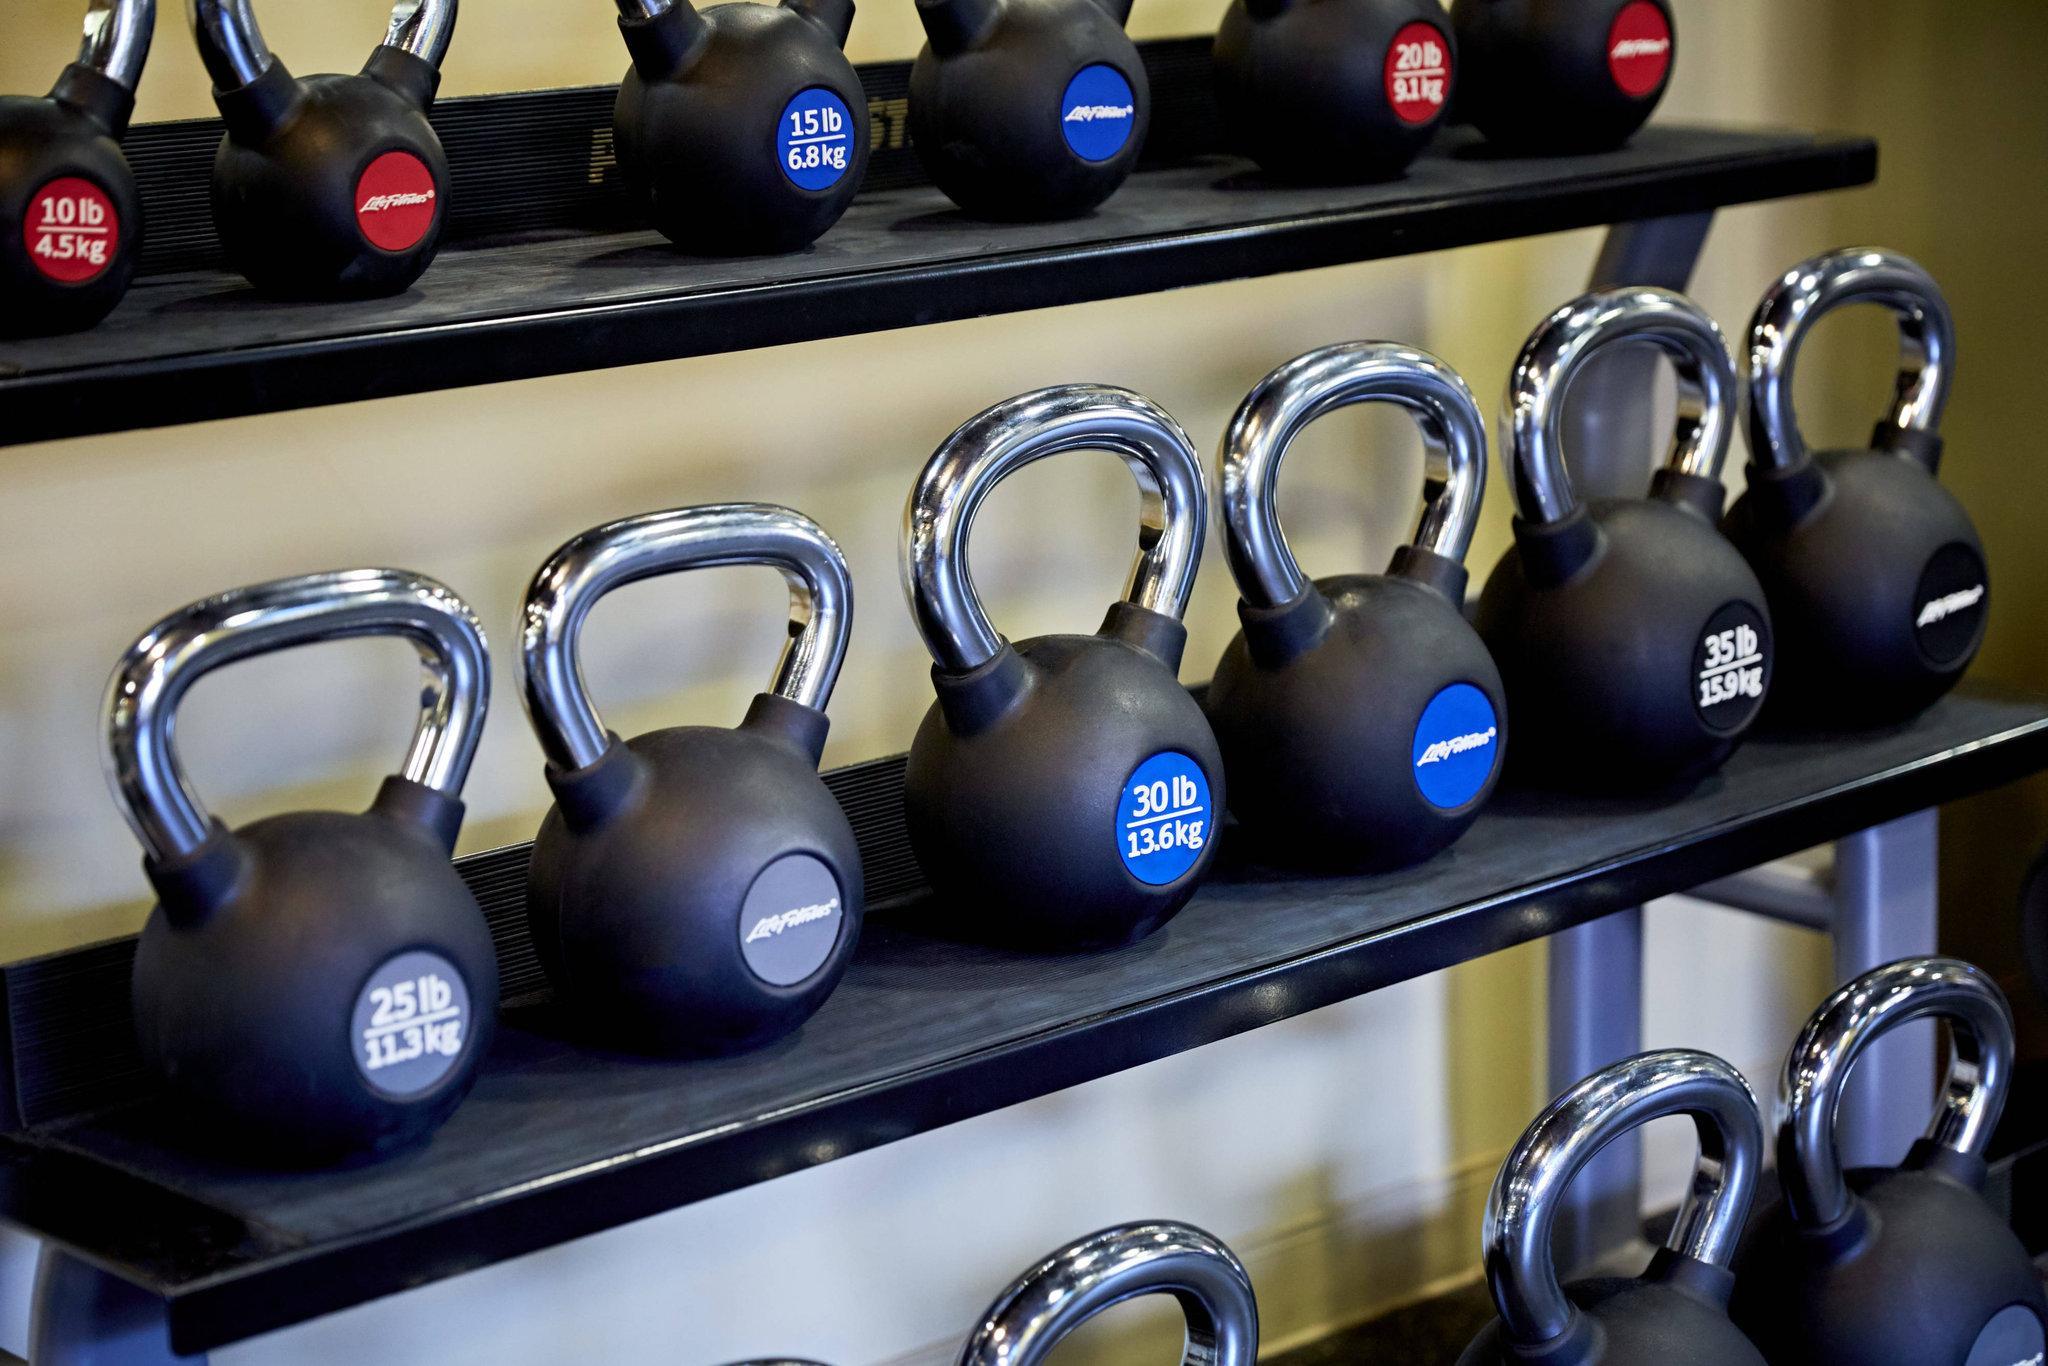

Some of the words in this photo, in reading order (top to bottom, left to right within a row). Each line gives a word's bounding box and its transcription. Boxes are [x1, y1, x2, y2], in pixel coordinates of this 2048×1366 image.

[1395, 43, 1423, 71] 20
[1423, 41, 1442, 69] lb
[790, 109, 819, 137] 15
[821, 106, 842, 133] lb
[41, 197, 76, 225] 10
[79, 197, 104, 225] lb
[1704, 629, 1736, 669] 35
[1735, 623, 1758, 659] lb
[1132, 780, 1169, 818] 30
[1172, 774, 1197, 809] lb
[369, 979, 418, 1028] 25
[418, 974, 452, 1015] lb
